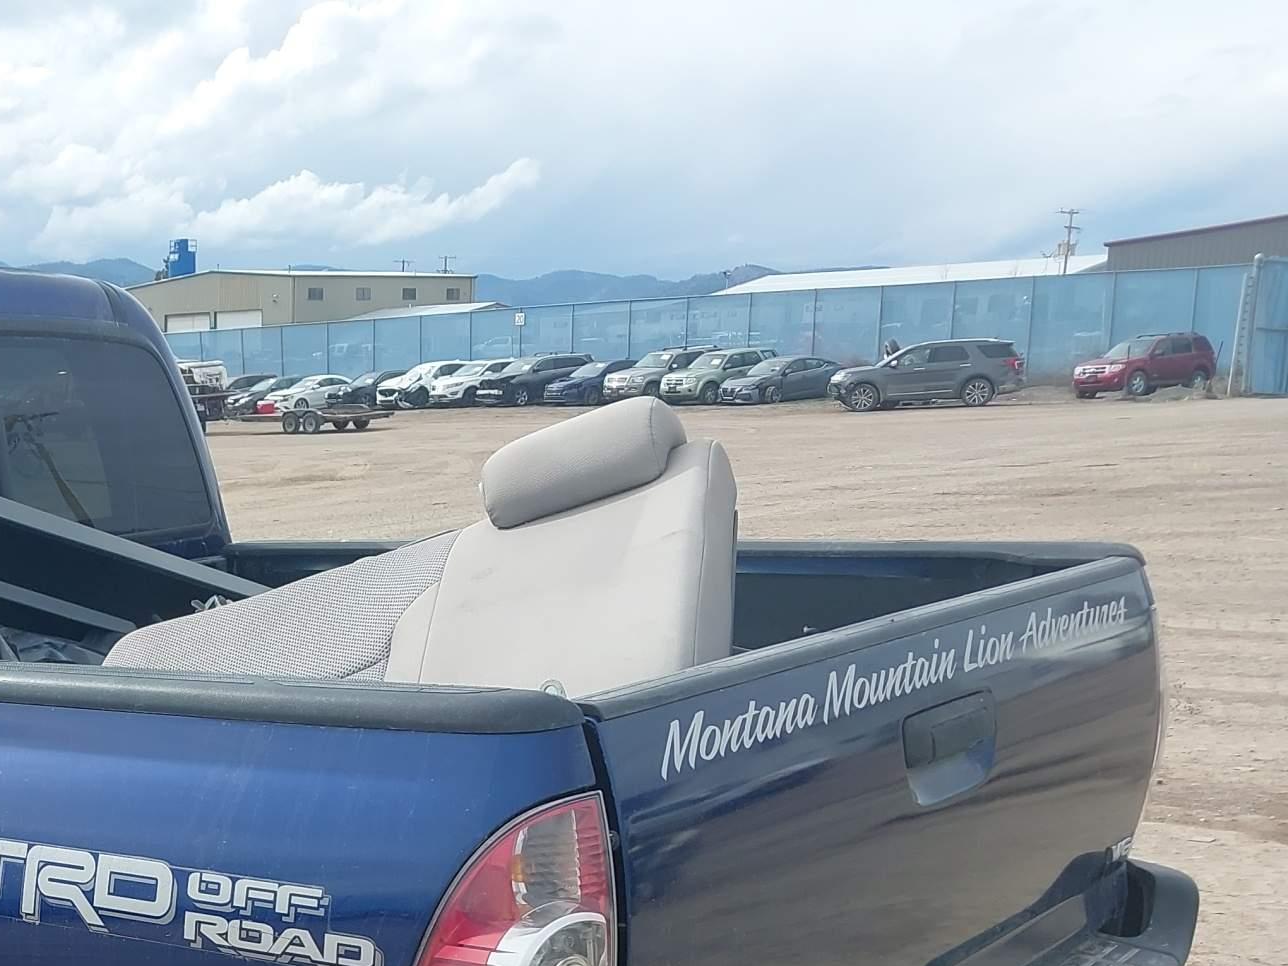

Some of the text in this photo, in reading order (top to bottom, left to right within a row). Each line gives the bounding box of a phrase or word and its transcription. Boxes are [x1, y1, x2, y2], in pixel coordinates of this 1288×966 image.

[661, 594, 1129, 782] Montana Mountain Lion Adventures
[186, 870, 330, 924] OFF
